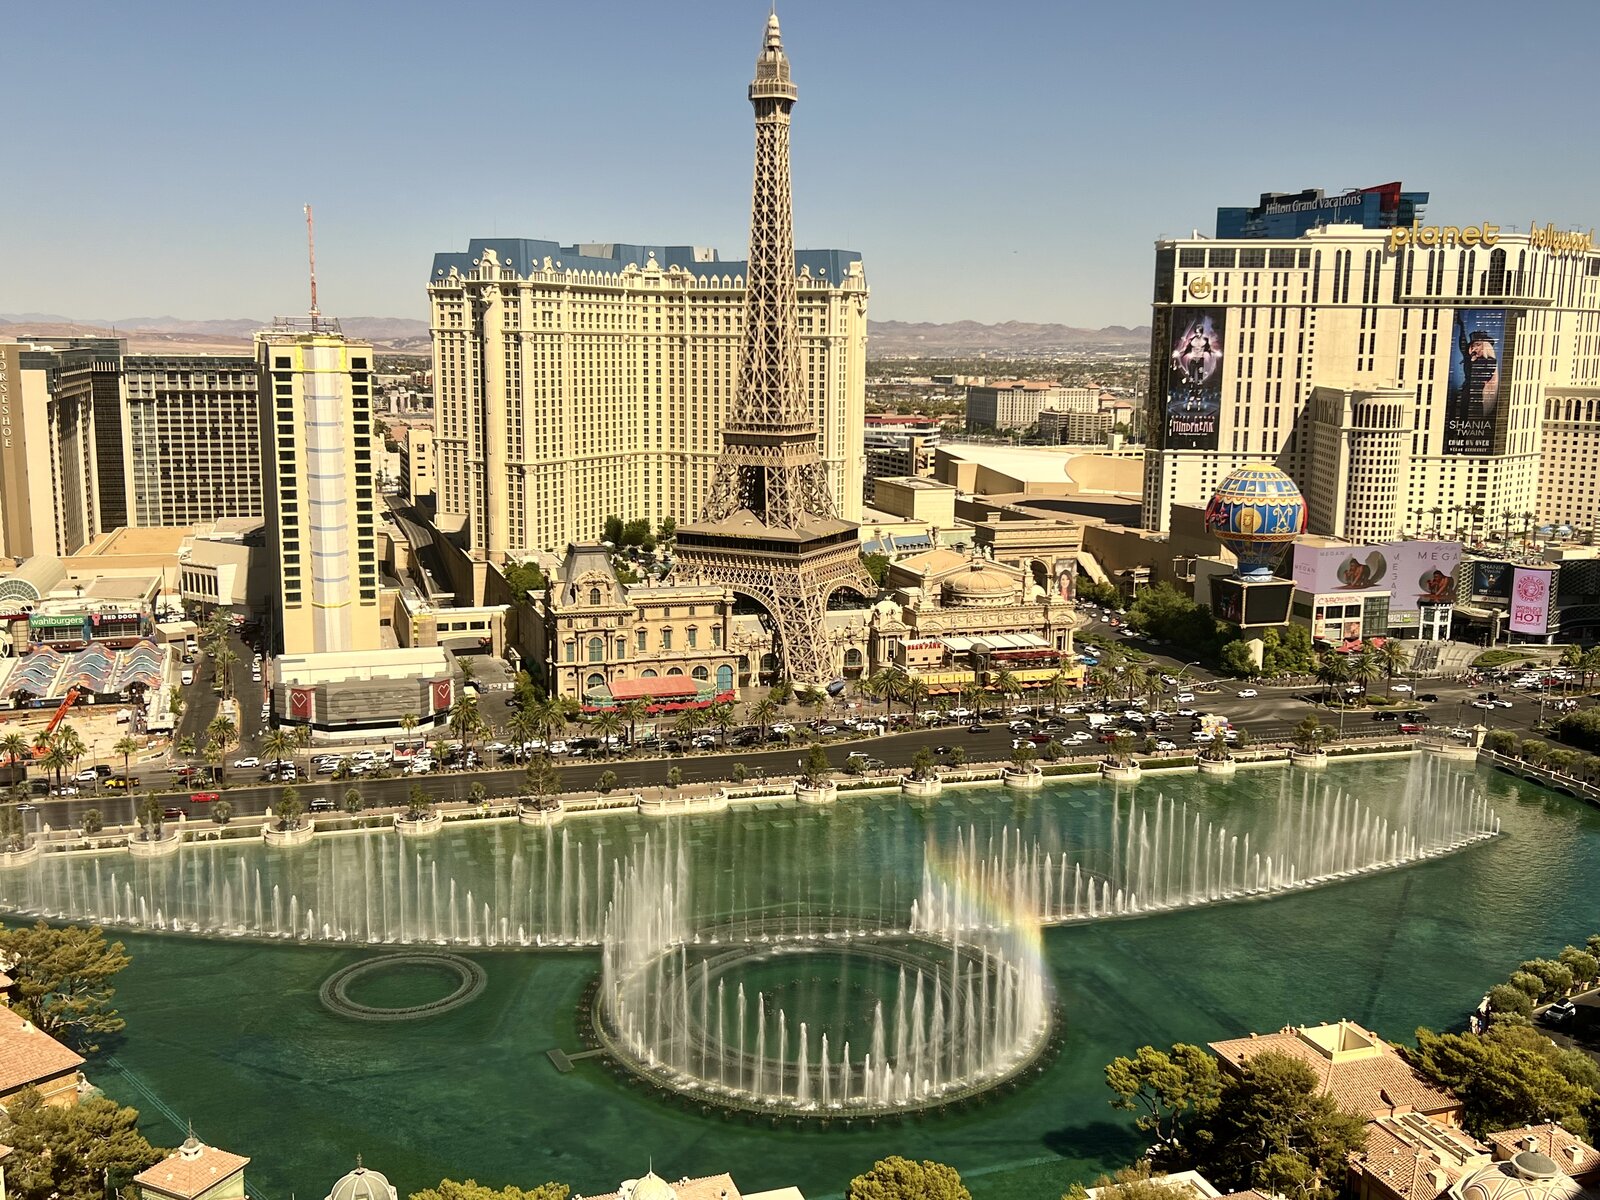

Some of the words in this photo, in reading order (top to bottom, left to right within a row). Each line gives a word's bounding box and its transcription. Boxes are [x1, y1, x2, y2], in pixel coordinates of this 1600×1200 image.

[1266, 202, 1291, 215] Hilton
[1292, 199, 1317, 212] Grand
[1320, 194, 1361, 209] Vacations
[1388, 218, 1500, 252] planet
[1531, 220, 1595, 256] hollywood
[1449, 420, 1492, 429] SHANIA
[31, 616, 84, 627] wahlburgers
[1514, 612, 1543, 622] HOT
[907, 643, 923, 651] BEER
